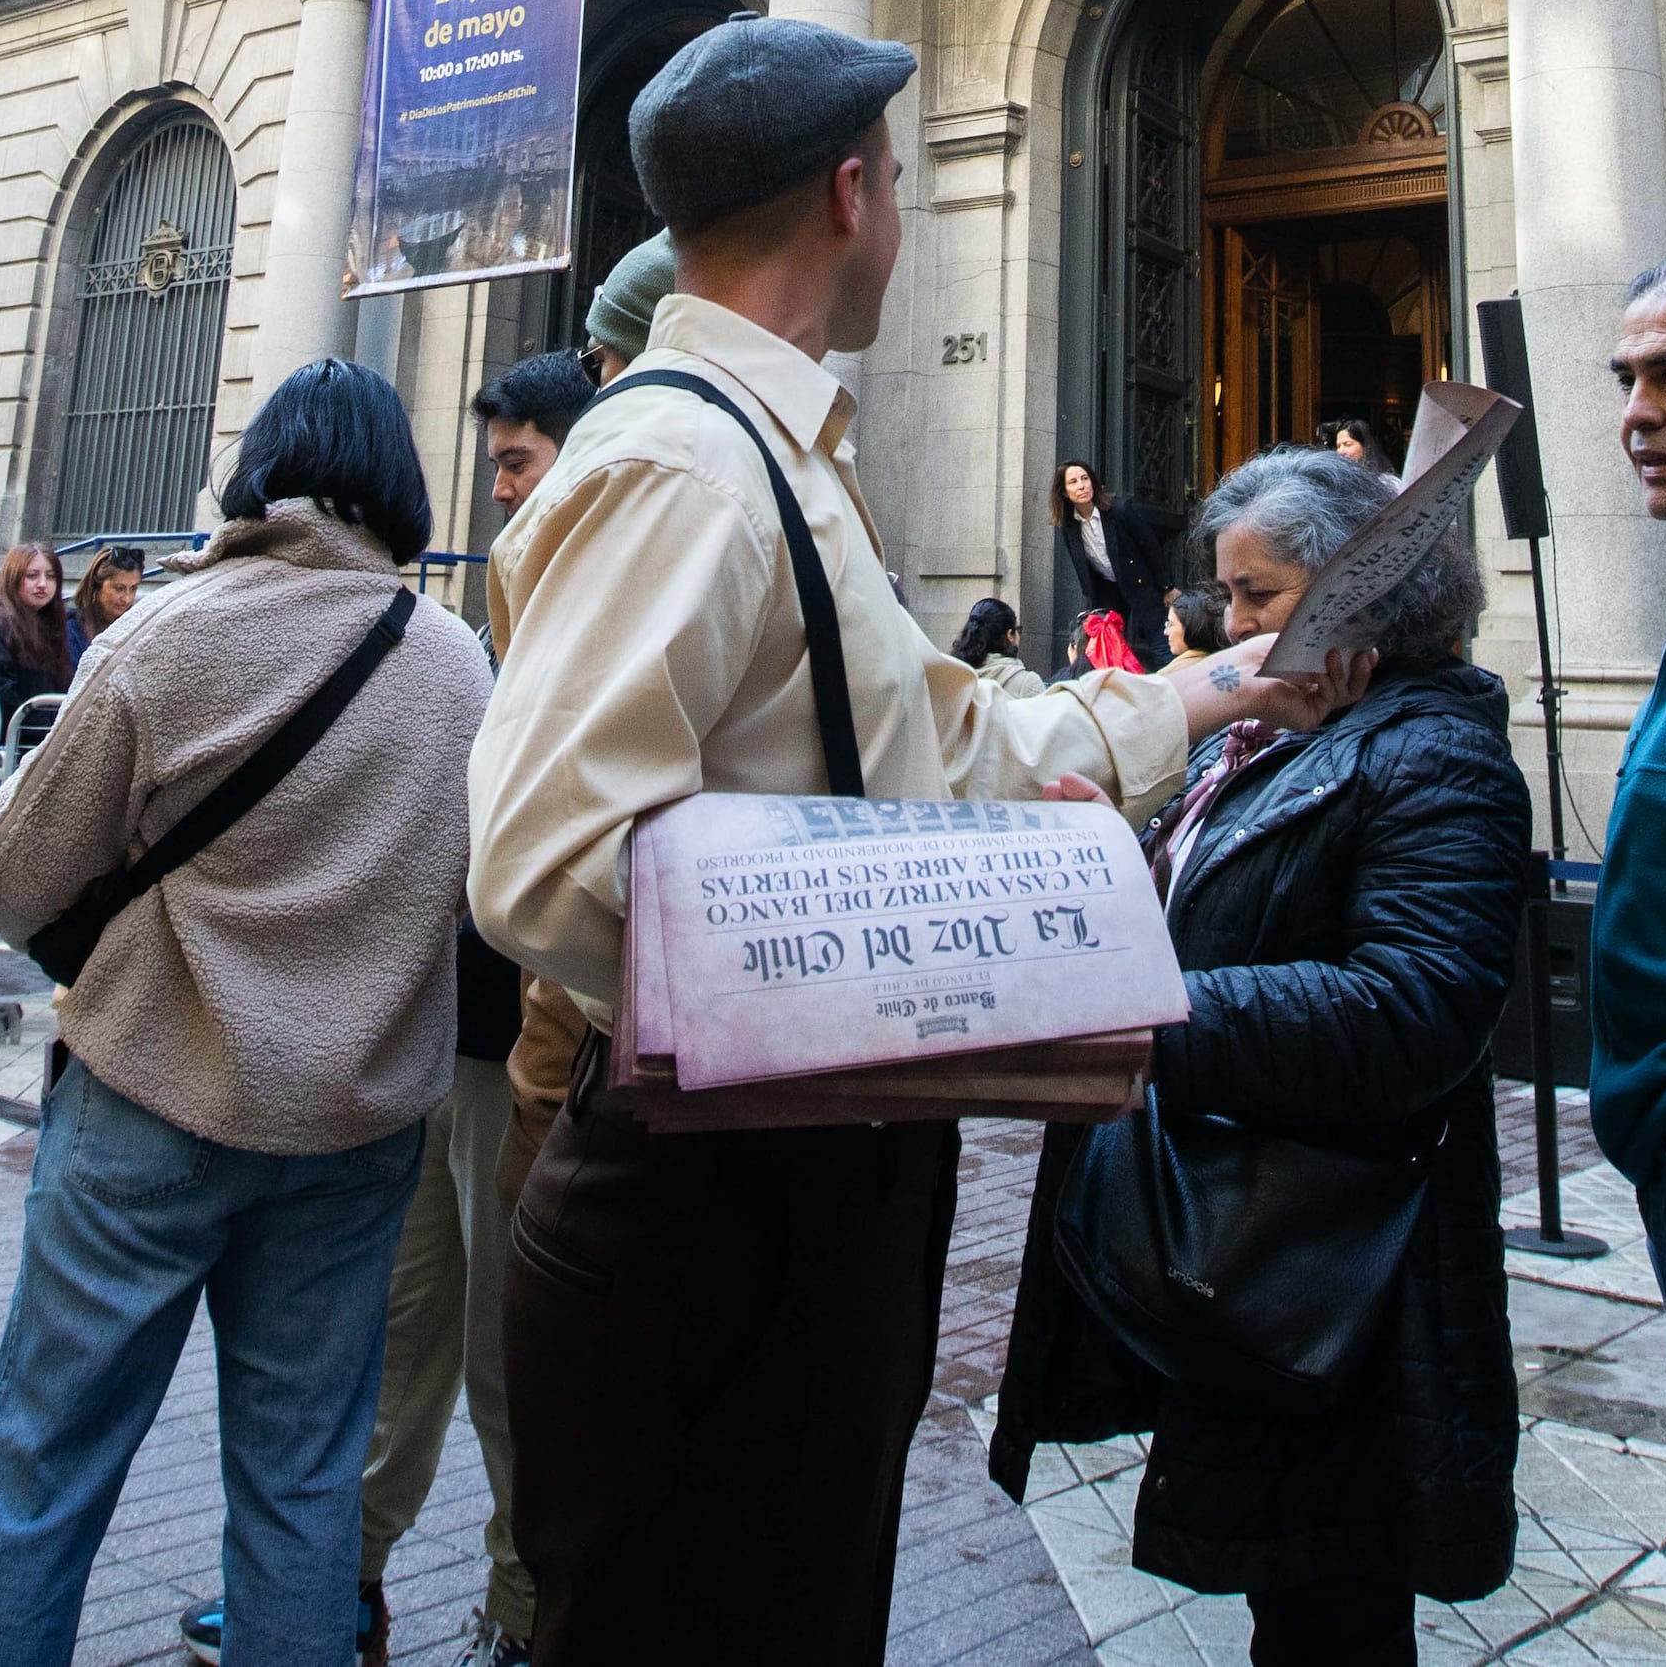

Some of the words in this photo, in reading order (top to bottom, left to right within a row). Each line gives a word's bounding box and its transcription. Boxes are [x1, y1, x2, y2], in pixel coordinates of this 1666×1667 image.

[424, 19, 451, 48] de
[457, 5, 525, 38] mayo
[419, 62, 453, 83] 10:00
[455, 63, 463, 75] a
[465, 52, 498, 72] 17:00
[500, 48, 524, 64] hrs.
[942, 332, 988, 365] 251
[917, 840, 939, 852] DE
[943, 835, 1013, 852] SÍMBOLO
[1018, 832, 1072, 846] NUEVO
[1076, 830, 1099, 842] UN
[697, 852, 784, 871] PROGRESO
[787, 850, 799, 862] Y
[803, 842, 913, 860] MODERNIDAD
[1066, 846, 1104, 865] DE
[894, 854, 967, 883] ABRE
[976, 848, 1062, 878] CHILE
[701, 868, 828, 900] PUERTAS
[837, 864, 887, 887] SUS
[999, 871, 1070, 900] CASA
[1073, 868, 1114, 889] LA
[815, 889, 871, 916] DEL
[879, 878, 991, 908] MATRIZ
[706, 895, 807, 925] BANCO
[928, 910, 1016, 958] Voz
[1033, 901, 1099, 949] La
[742, 931, 844, 982] Chile
[862, 926, 913, 970] del
[873, 980, 909, 992] CHILE
[912, 978, 929, 989] DE
[933, 973, 972, 986] BANCO
[977, 971, 991, 981] EL
[877, 999, 916, 1018] Chile
[923, 997, 939, 1013] de
[945, 991, 995, 1010] Banco
